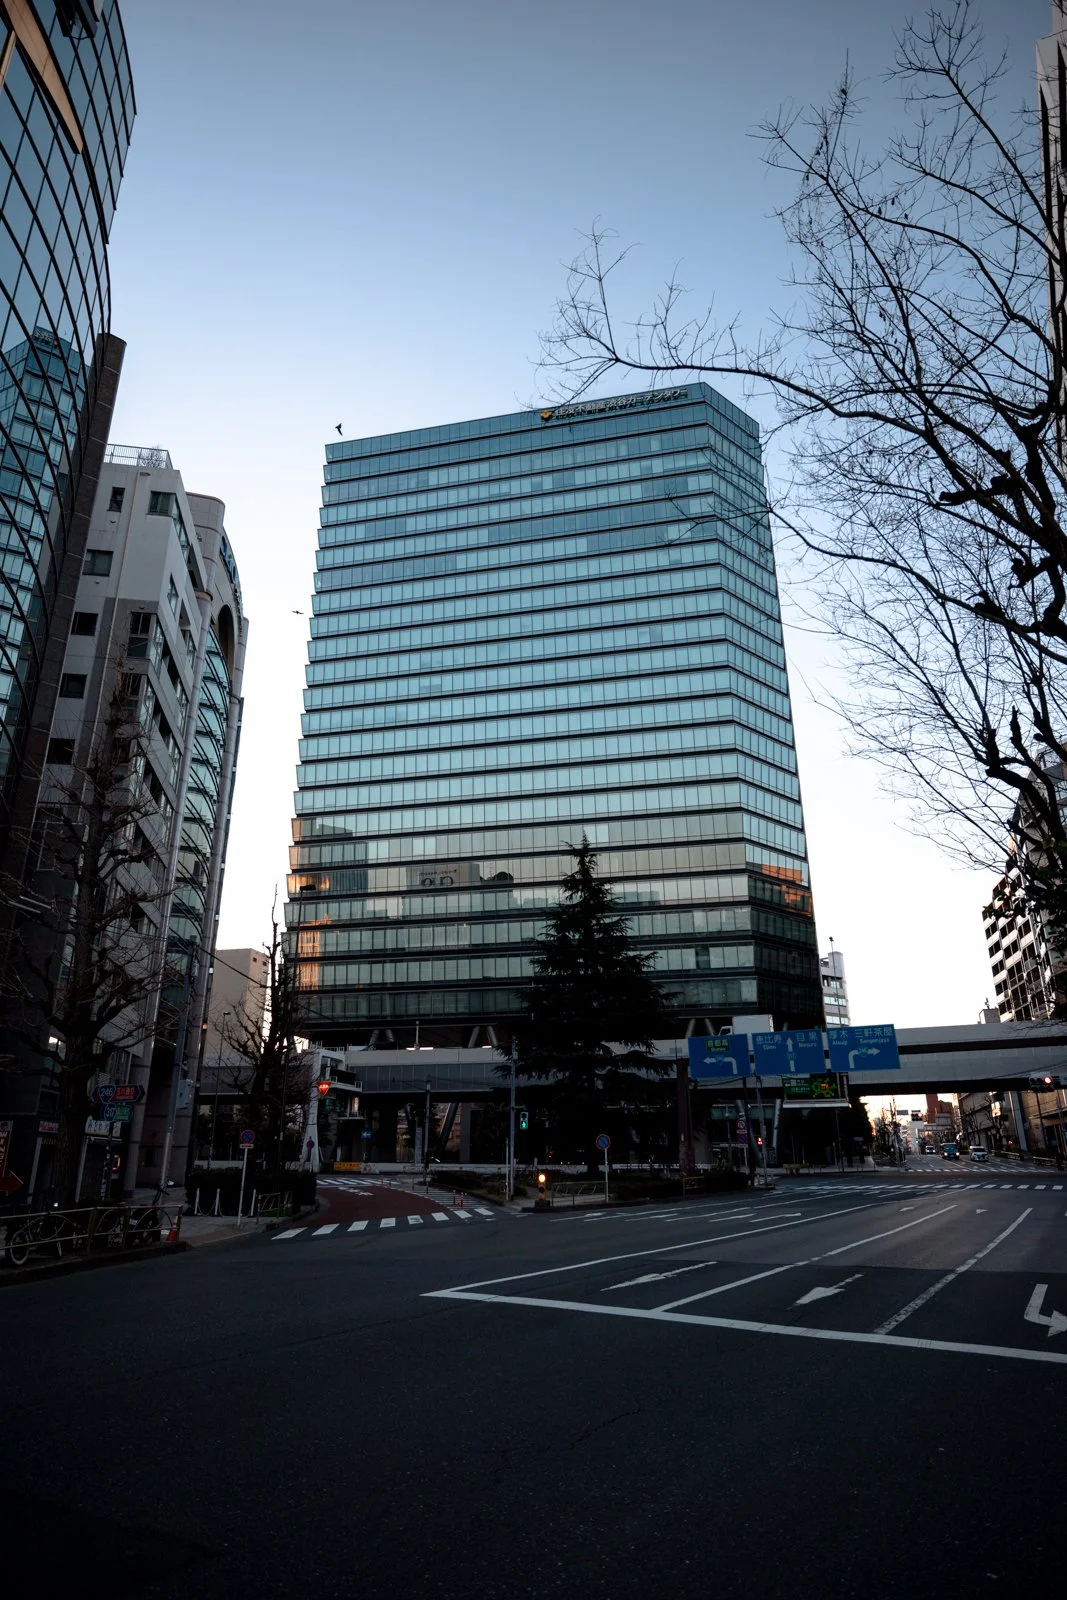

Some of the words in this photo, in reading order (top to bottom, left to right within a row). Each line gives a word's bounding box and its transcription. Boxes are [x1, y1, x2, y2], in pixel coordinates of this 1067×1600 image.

[755, 1033, 782, 1044] 恵比寿
[796, 1031, 818, 1042] 目黒
[100, 1087, 113, 1097] 246
